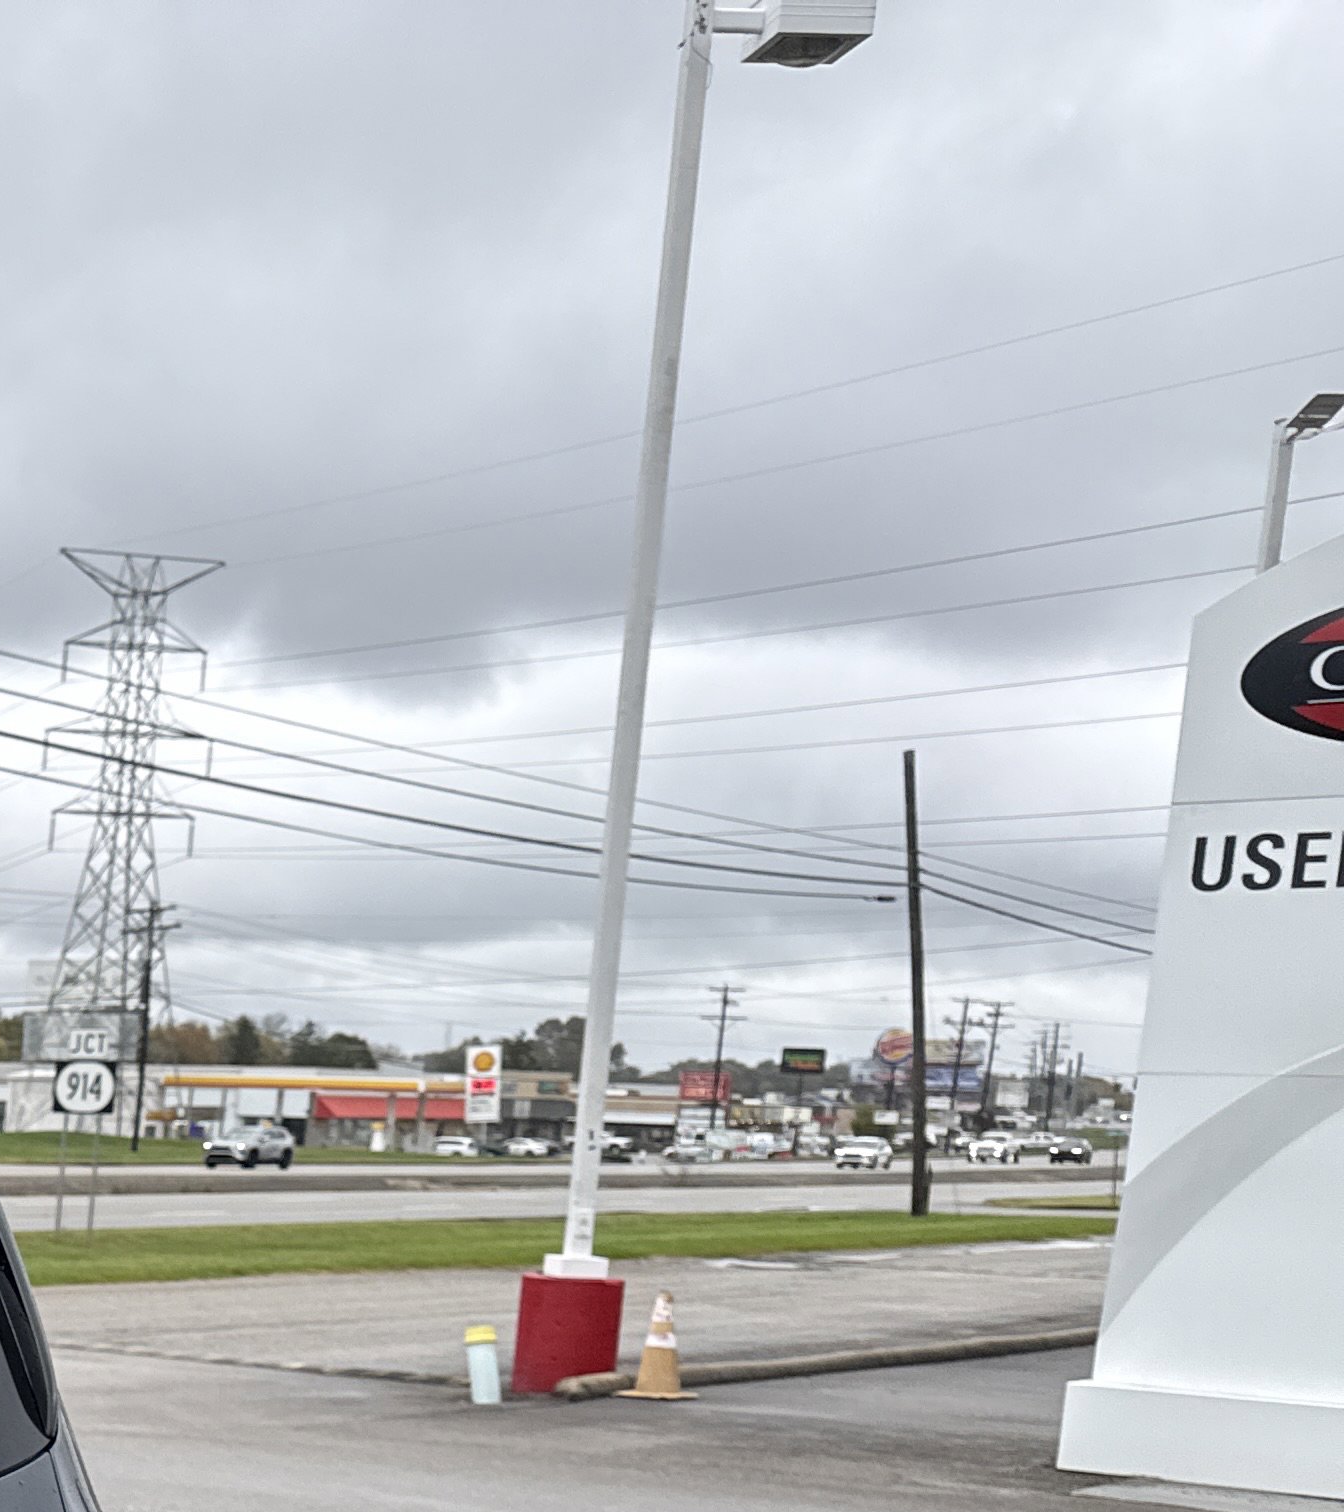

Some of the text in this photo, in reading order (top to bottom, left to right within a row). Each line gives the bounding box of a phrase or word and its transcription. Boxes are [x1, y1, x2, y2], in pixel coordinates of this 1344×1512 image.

[1191, 831, 1344, 892] USE
[72, 1032, 107, 1054] JCT
[66, 1071, 103, 1101] 914
